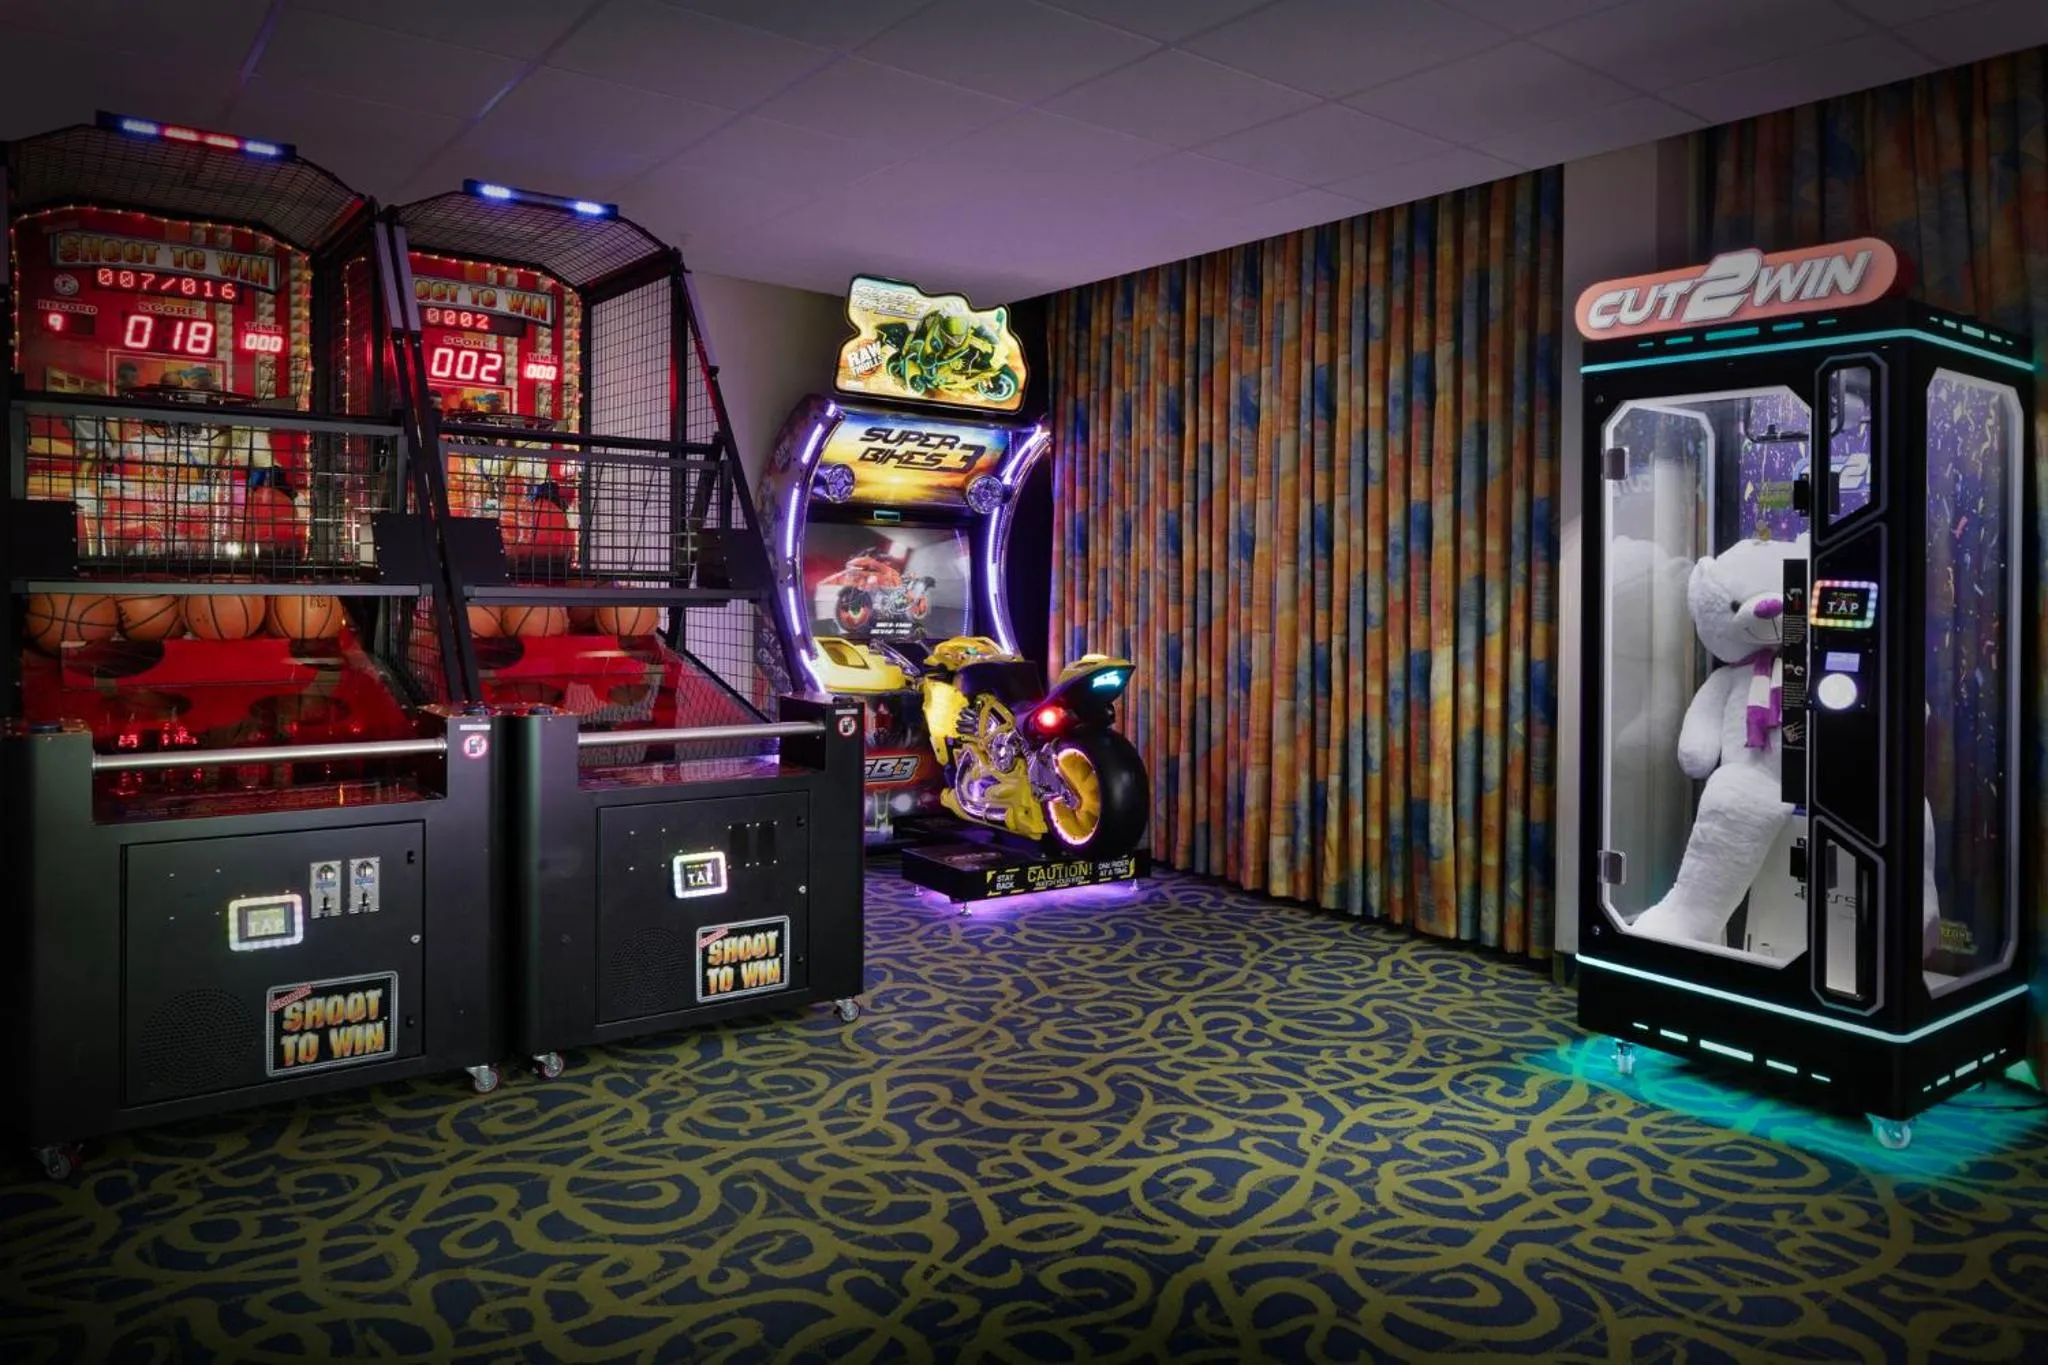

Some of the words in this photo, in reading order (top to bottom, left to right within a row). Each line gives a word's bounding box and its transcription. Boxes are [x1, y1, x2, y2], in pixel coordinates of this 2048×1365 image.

[59, 233, 161, 266] SHOOT
[170, 247, 206, 272] TO
[216, 252, 270, 284] WIN
[97, 268, 237, 299] 007/016
[1587, 248, 1872, 330] CUT2WIN
[137, 302, 199, 316] SCORE
[414, 279, 462, 303] OOT
[468, 286, 498, 308] TO
[505, 291, 548, 321] WIN
[245, 333, 283, 352] 000
[443, 335, 494, 349] SCORE
[431, 347, 503, 382] 002
[525, 364, 557, 380] 000
[859, 427, 961, 450] SUPER
[858, 447, 949, 467] BIKES
[1827, 600, 1859, 613] TAP
[996, 874, 1015, 882] STAY
[1027, 861, 1093, 882] CAUTION!
[996, 882, 1015, 890] BACK
[707, 930, 779, 965] SHOOT
[706, 965, 734, 994] TO
[741, 957, 781, 988] WIN
[282, 988, 382, 1031] SHOOT
[281, 1032, 319, 1066] TO
[329, 1021, 385, 1058] WIN
